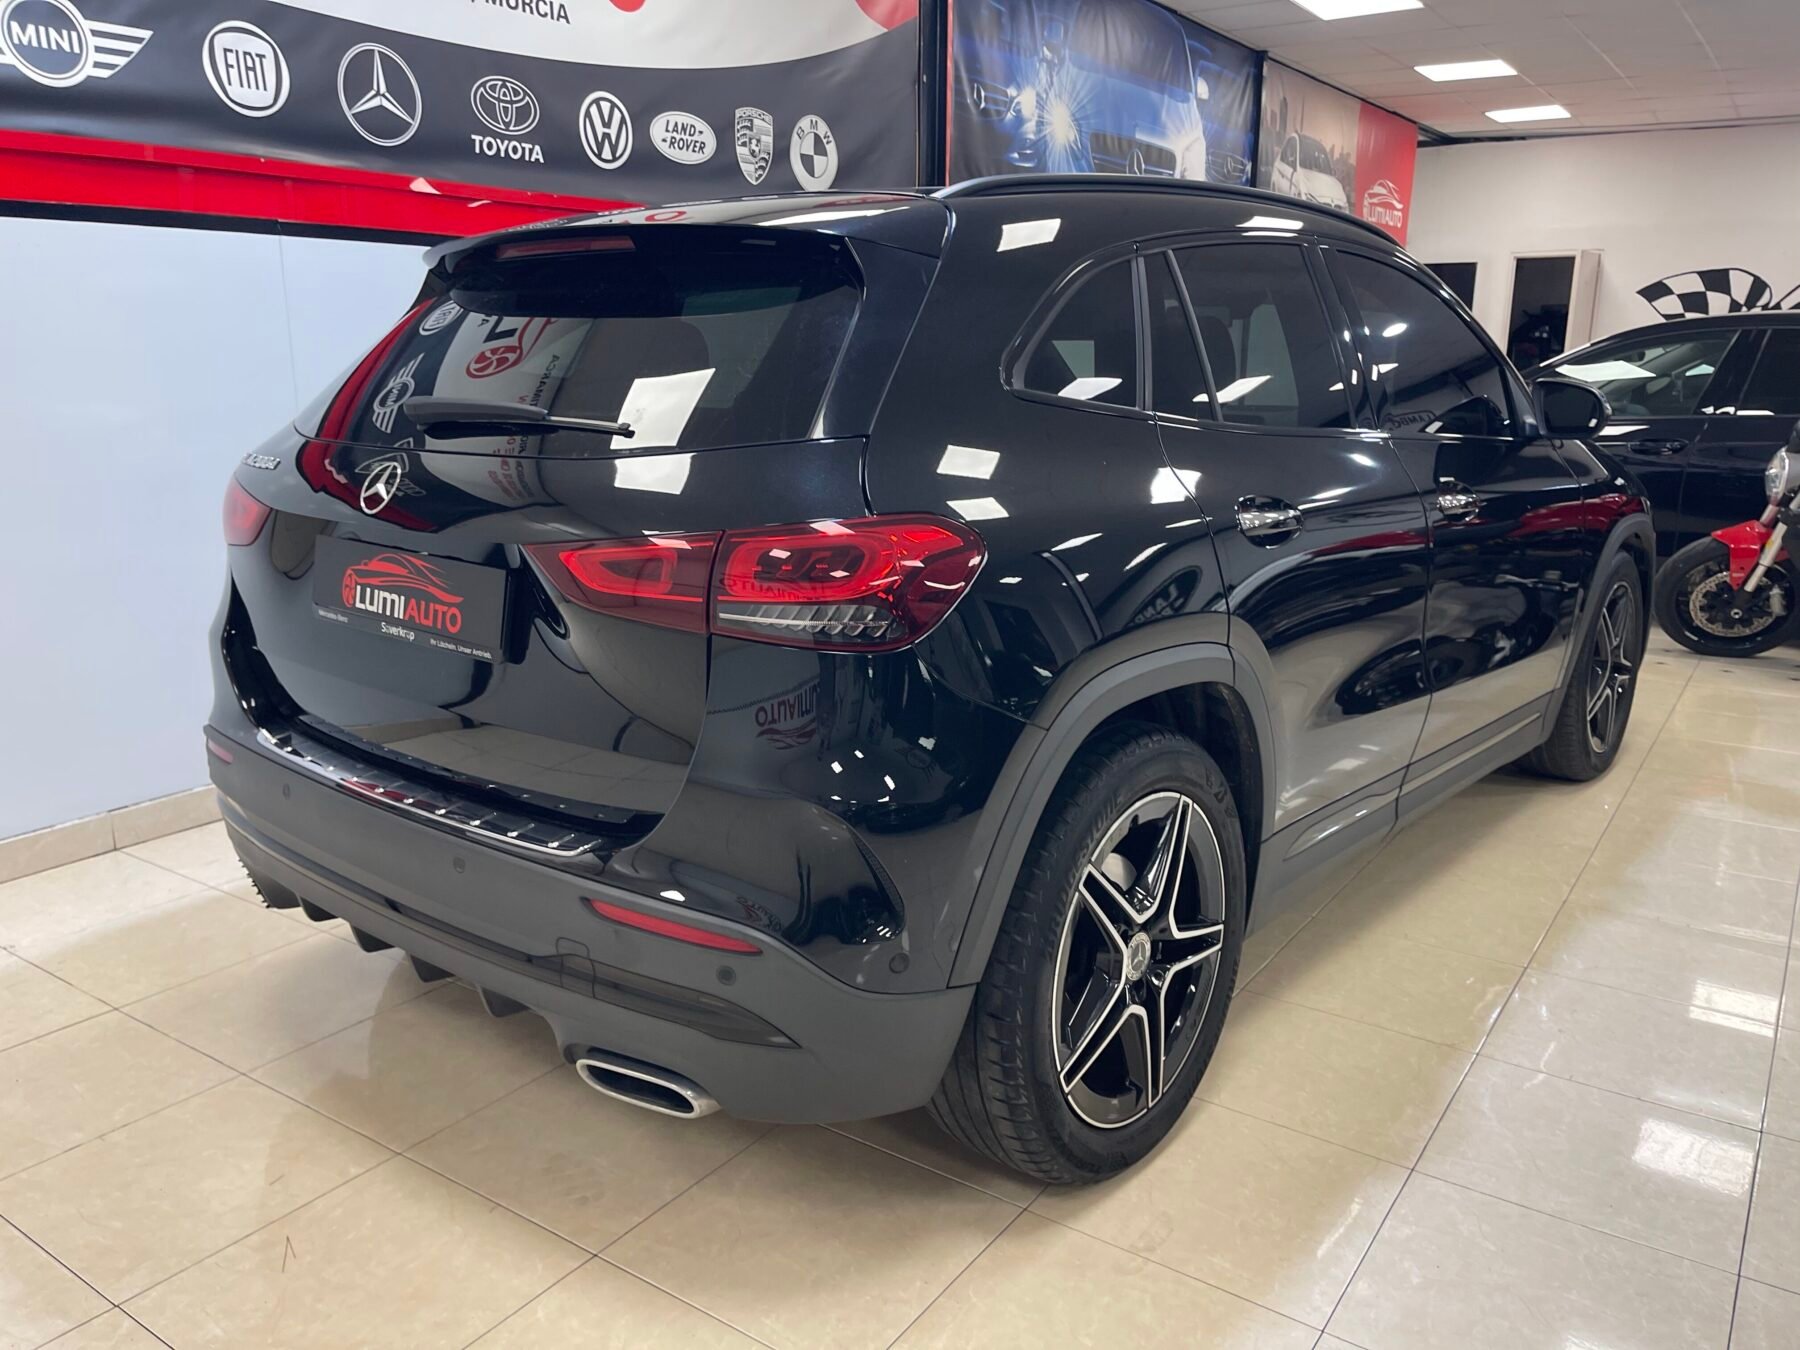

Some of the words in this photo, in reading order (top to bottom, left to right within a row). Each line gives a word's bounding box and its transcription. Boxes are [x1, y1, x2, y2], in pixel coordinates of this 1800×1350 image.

[11, 20, 81, 54] MINI
[222, 47, 270, 92] FIAT
[471, 134, 544, 164] TOYOTA
[668, 135, 706, 155] ROVER
[354, 585, 463, 634] LUMIAUTO
